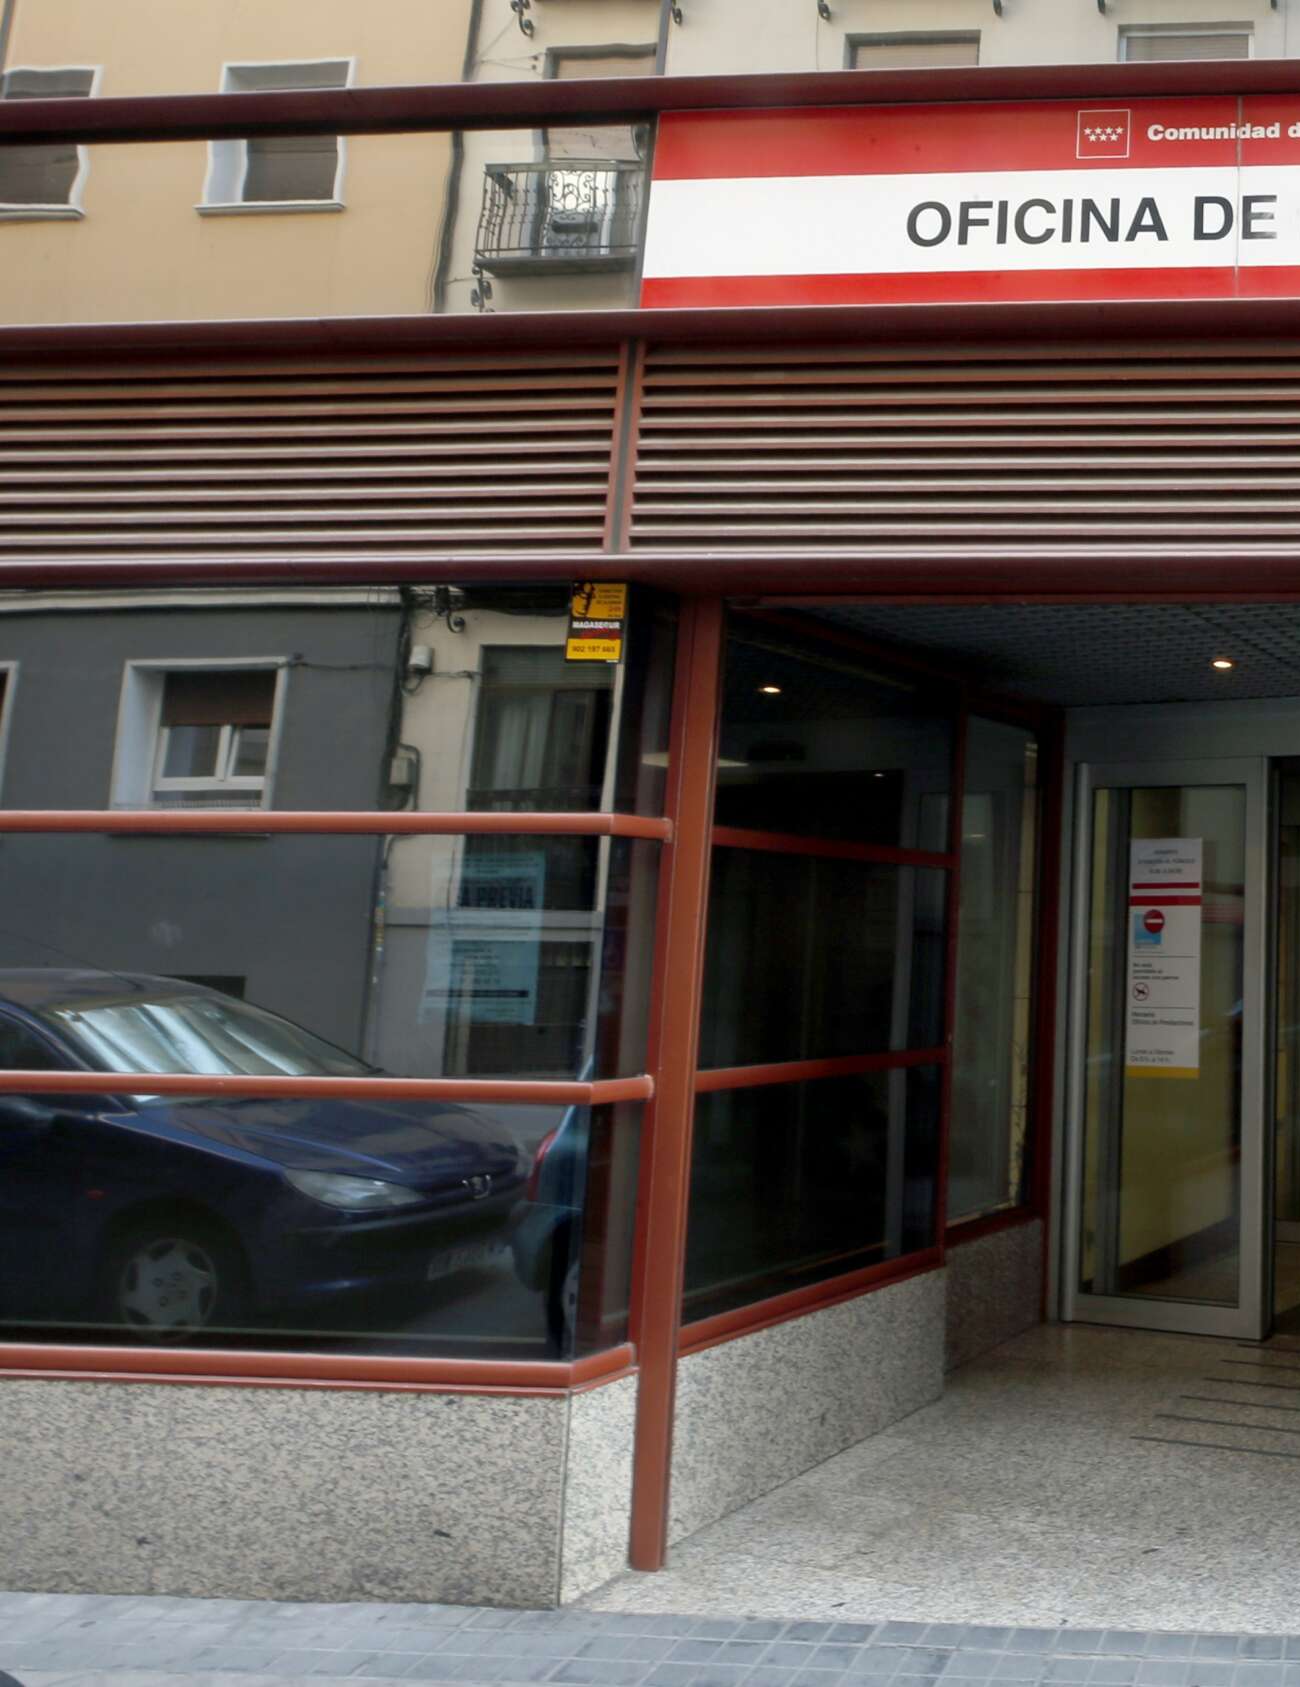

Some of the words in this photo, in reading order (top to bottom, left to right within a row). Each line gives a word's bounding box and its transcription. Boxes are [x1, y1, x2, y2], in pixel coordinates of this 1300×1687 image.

[1147, 122, 1281, 141] Comunidad
[906, 197, 1169, 248] OFICINA
[1193, 194, 1278, 241] DE
